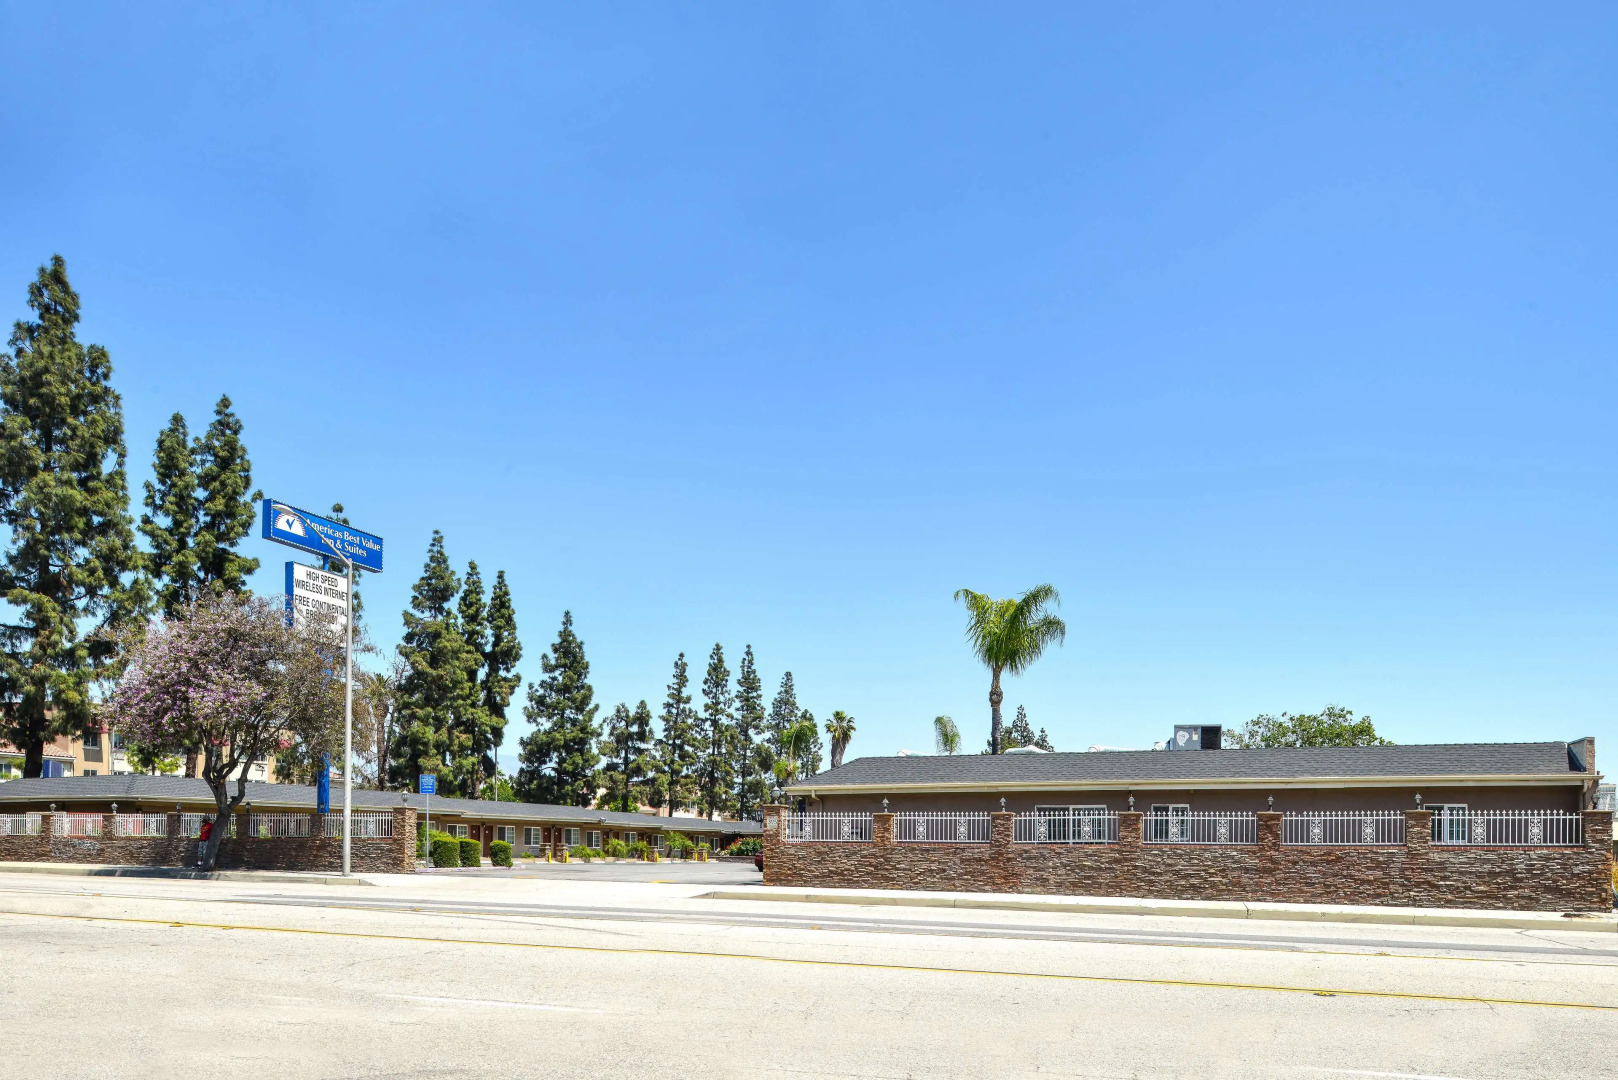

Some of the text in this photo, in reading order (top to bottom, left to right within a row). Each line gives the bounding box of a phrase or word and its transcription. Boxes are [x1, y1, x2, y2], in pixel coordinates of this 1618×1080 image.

[305, 518, 381, 552] Americas Best Value
[336, 538, 343, 550] &
[344, 541, 367, 558] Suites
[294, 577, 347, 602] WIRELESS INTERNET
[305, 569, 339, 588] HIGH SPEED
[294, 594, 347, 617] FREE CONTINENTAL
